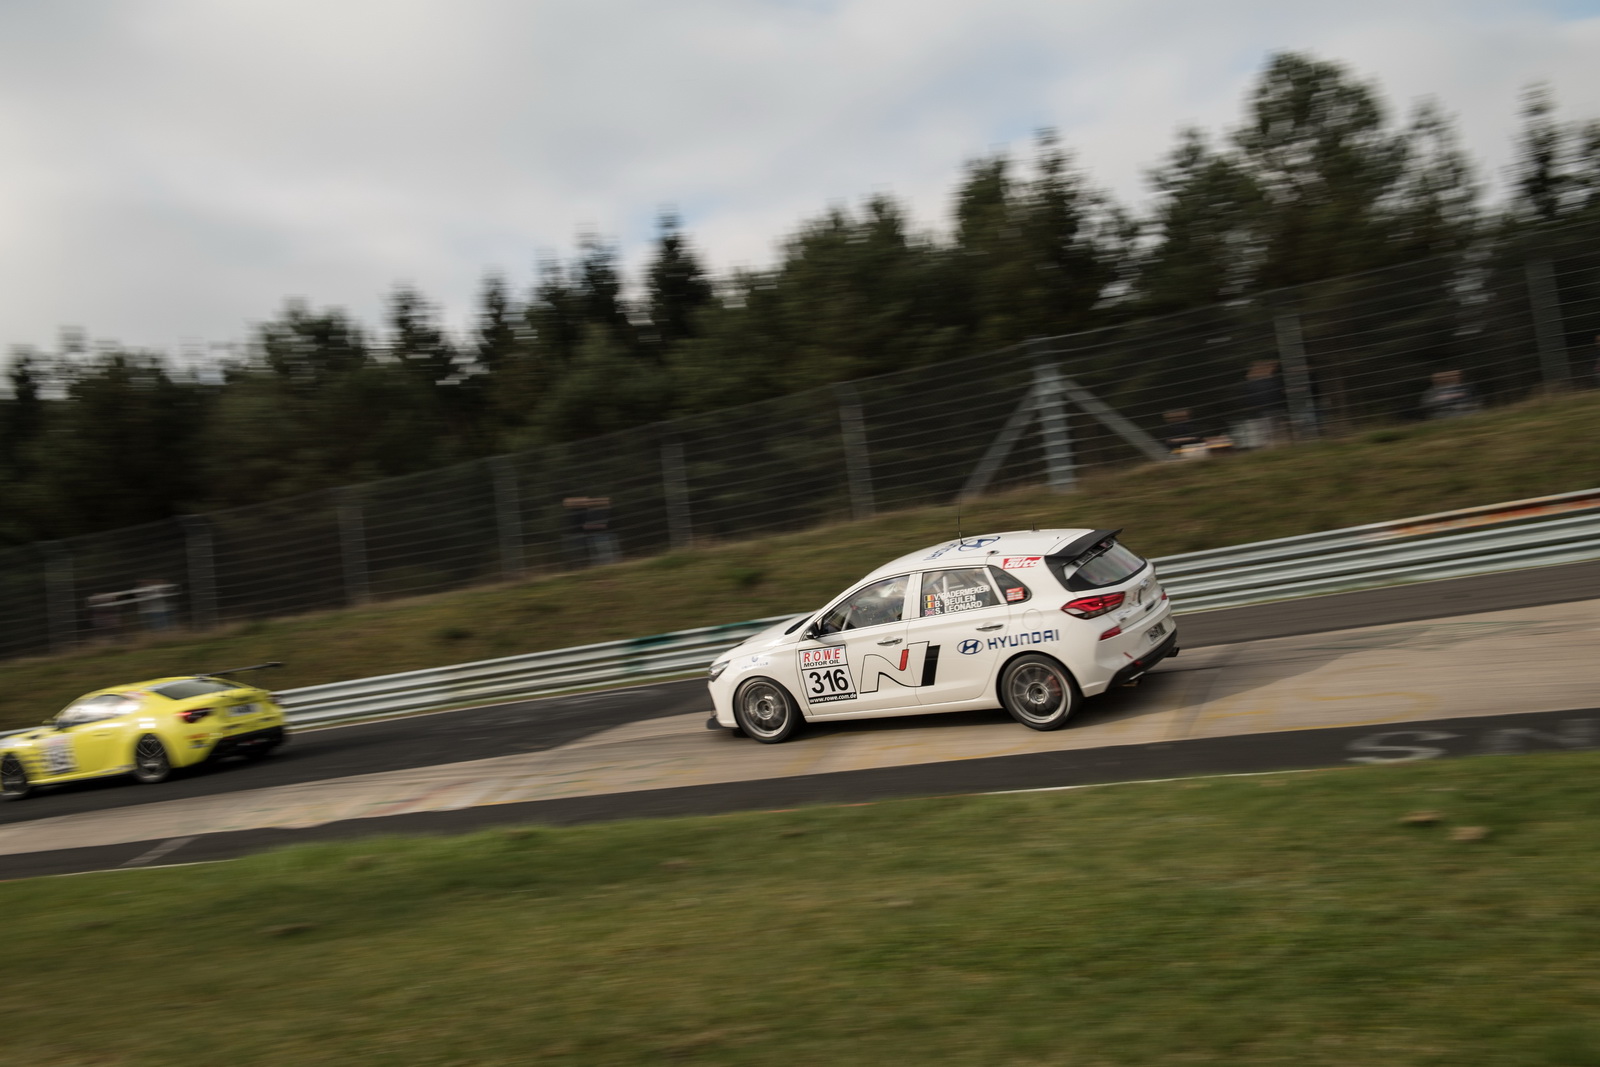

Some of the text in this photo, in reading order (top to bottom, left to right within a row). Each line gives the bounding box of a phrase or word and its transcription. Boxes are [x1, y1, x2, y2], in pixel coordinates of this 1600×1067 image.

[934, 594, 976, 608] B. BEULEN
[935, 600, 983, 615] S. LEONARD
[987, 629, 1059, 650] HYUNDAI
[803, 648, 841, 662] ROWE
[803, 660, 828, 668] MOTOR
[809, 668, 849, 694] 316
[809, 692, 857, 704] www.rowe.com.de
